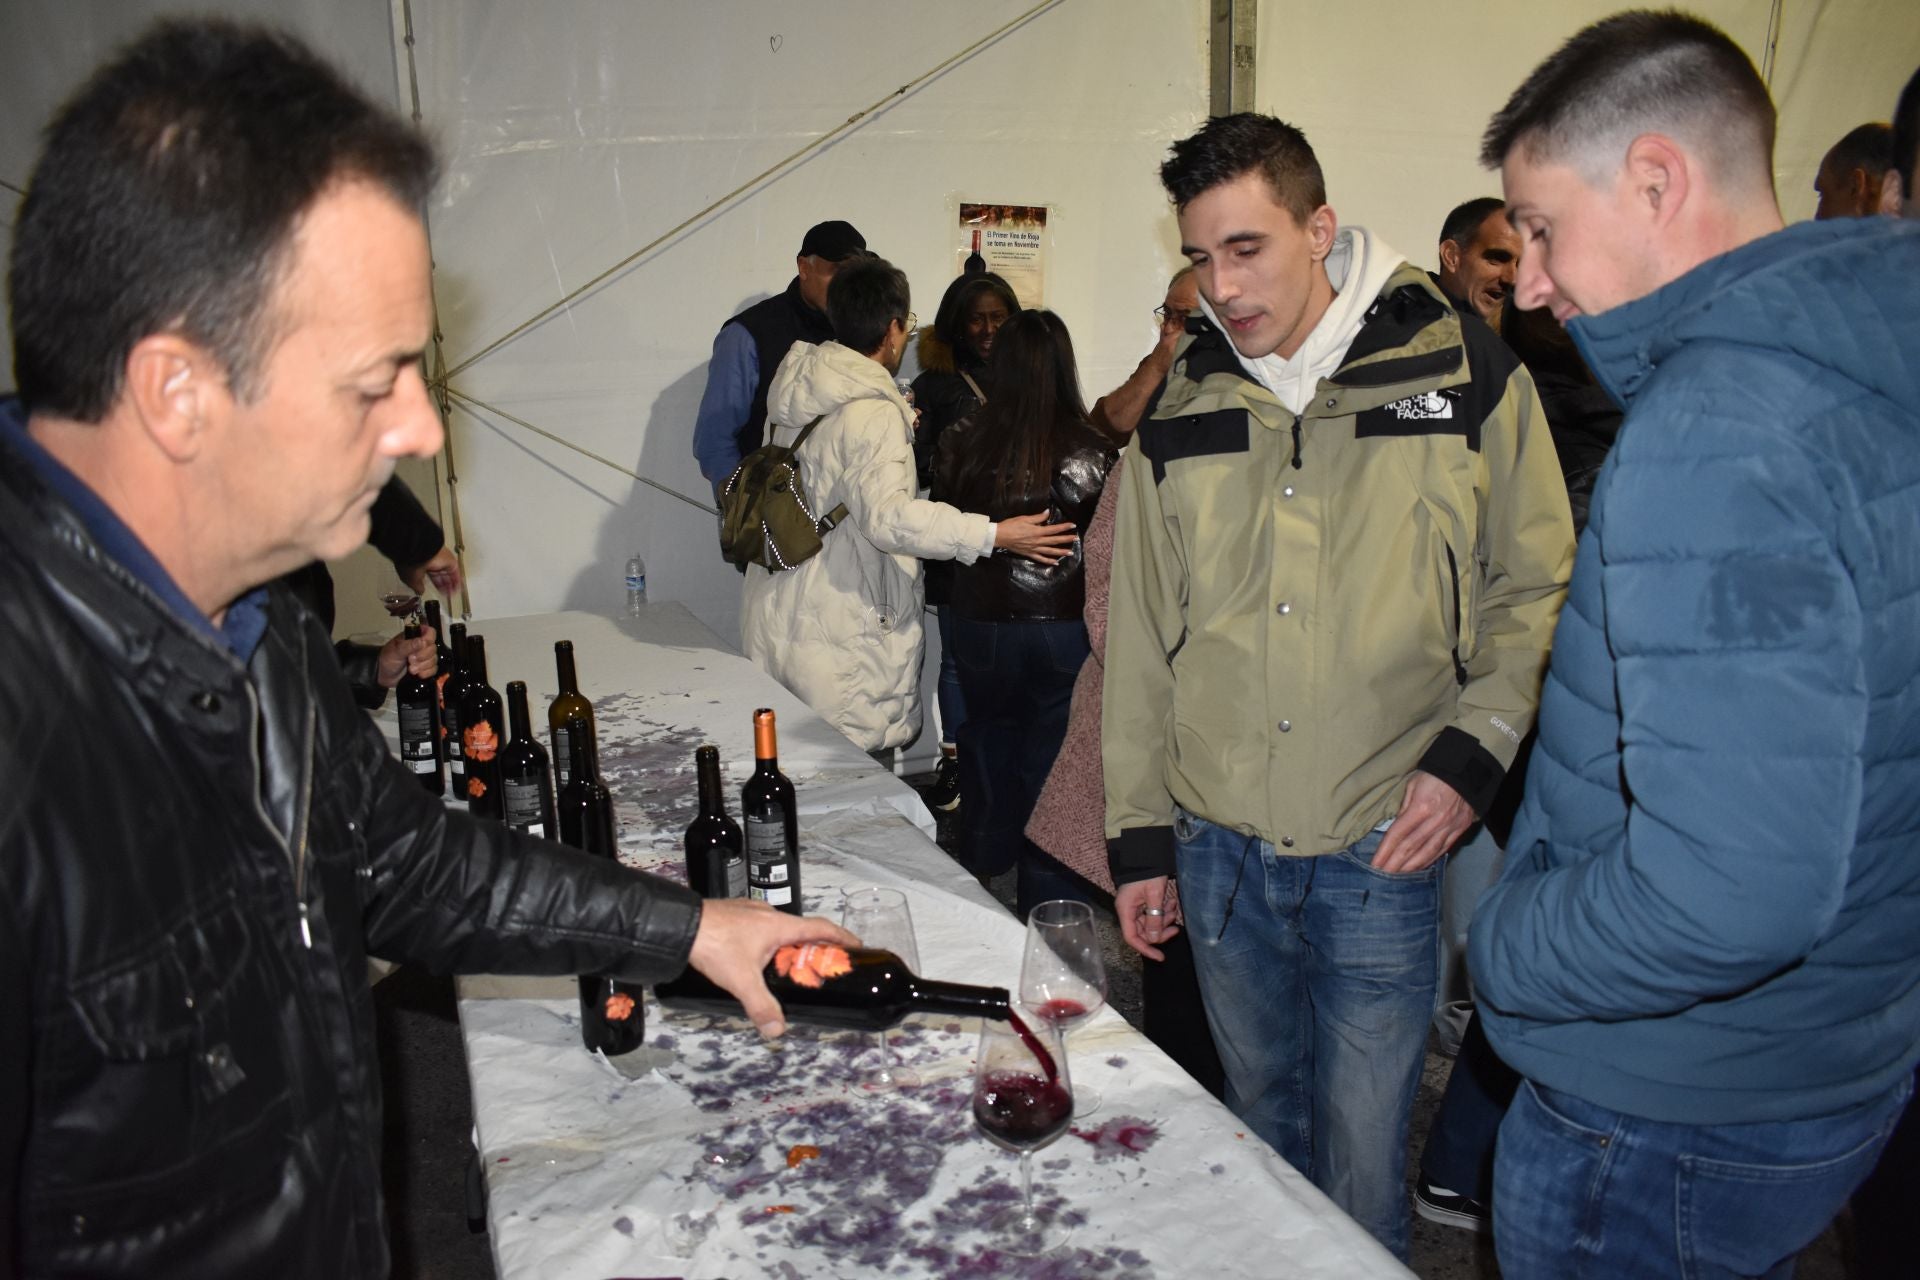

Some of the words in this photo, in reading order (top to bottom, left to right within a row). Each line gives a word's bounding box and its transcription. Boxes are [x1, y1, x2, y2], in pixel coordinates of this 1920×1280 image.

[993, 231, 1008, 239] Primer
[1028, 233, 1040, 241] Rioja
[1397, 408, 1428, 419] FACE
[1490, 716, 1520, 744] GORE-TE
